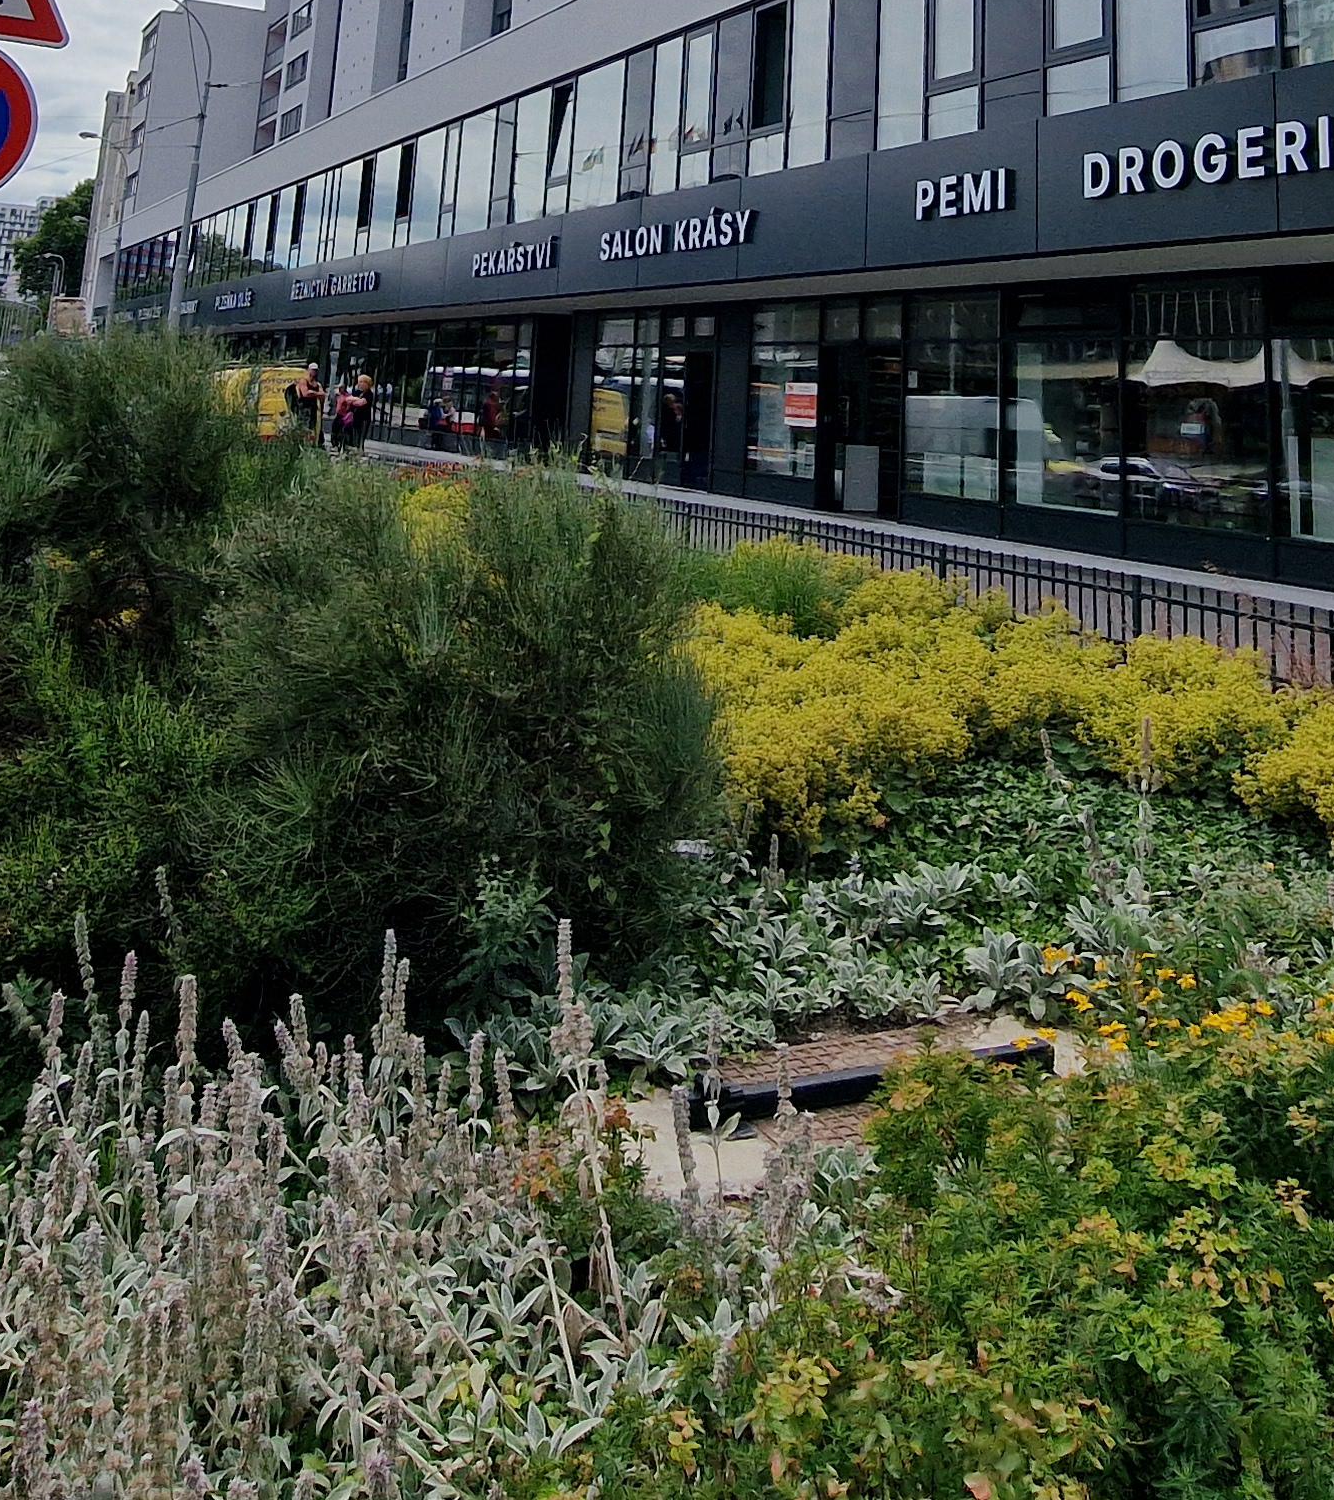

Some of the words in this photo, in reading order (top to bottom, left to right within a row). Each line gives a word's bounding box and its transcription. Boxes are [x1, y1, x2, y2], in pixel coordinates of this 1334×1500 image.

[915, 167, 1006, 221] PEMI
[471, 235, 553, 278] PEKAŘSTVÍ
[599, 223, 663, 262] SALON
[673, 205, 752, 252] KRÁSY
[330, 270, 376, 296] GARRETTO
